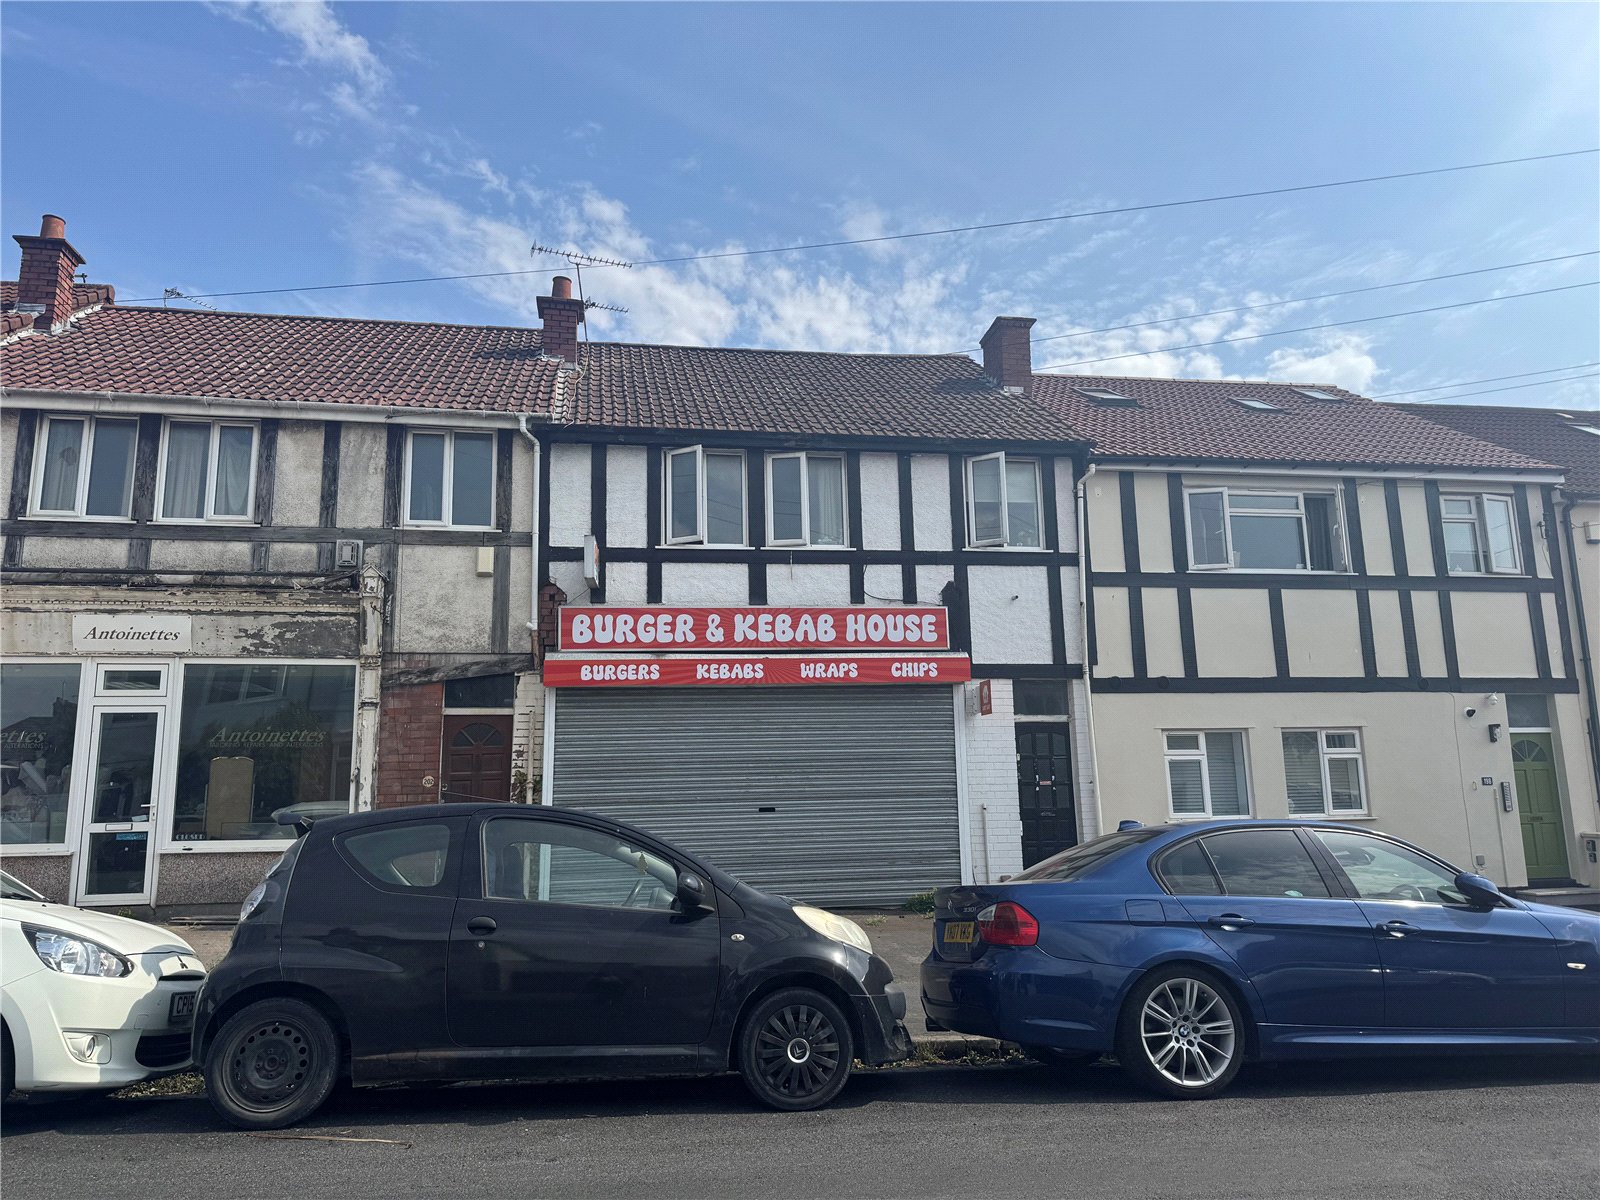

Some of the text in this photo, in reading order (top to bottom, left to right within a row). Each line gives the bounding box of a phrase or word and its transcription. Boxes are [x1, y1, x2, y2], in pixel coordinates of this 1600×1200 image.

[83, 626, 181, 642] Antoinettes
[571, 613, 938, 644] BURGER & KEBAB HOUSE
[580, 662, 938, 681] BURGERS KEBABS WRAPS CHIPS
[208, 726, 327, 743] Antoinettes
